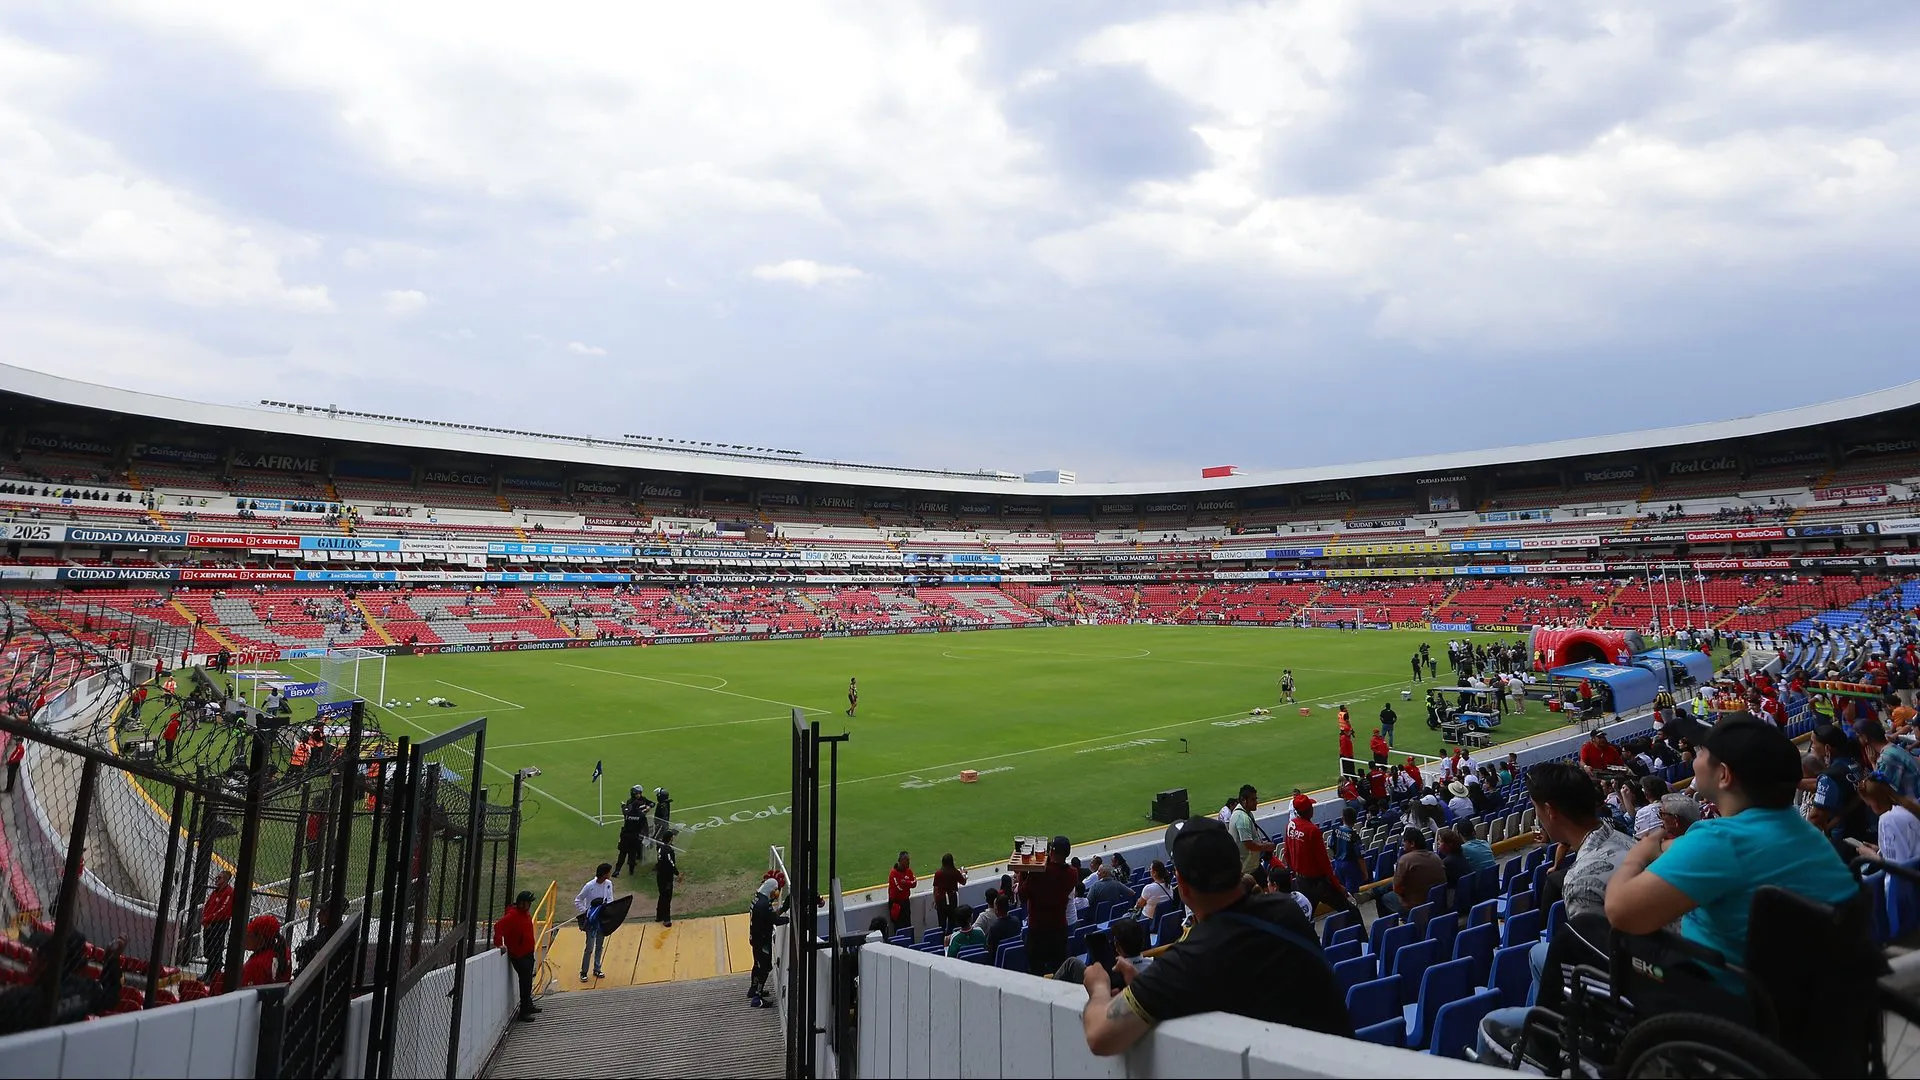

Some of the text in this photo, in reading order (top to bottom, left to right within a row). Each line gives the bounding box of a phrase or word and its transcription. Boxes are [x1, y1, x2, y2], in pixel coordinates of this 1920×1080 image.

[149, 449, 218, 463] Construlandia
[254, 455, 319, 471] AFIRME
[1670, 457, 1736, 474] Red Cola
[424, 471, 459, 483] ARMO
[577, 482, 616, 494] Pack3000
[642, 485, 682, 497] Keuka
[820, 498, 855, 508] AFIRME
[918, 503, 949, 512] AFIRME
[586, 518, 618, 526] HARINERA
[1349, 518, 1403, 529] CIUDAD ADERAS
[13, 526, 51, 540] 2025
[72, 529, 182, 545] CIUDAD MADERAS
[1688, 532, 1733, 541] QuattroCom
[1736, 529, 1782, 539] QuattroCom
[206, 536, 244, 544] XENTRAL
[261, 538, 299, 546] XENTRAL
[1650, 534, 1685, 542] caliente.mx
[317, 537, 363, 549] GALLOS
[693, 550, 747, 558] CIUDAD MADERAS
[805, 552, 846, 560] 1950 2025
[1105, 554, 1129, 562] CIUDAD
[1613, 563, 1646, 571] caliente.mx
[1693, 561, 1739, 569] QuattroCom
[1742, 559, 1789, 568] QuattroCom
[67, 568, 171, 580] CIUDAD MADERAS
[255, 571, 292, 579] XENTRAL
[307, 571, 320, 580] QFC
[372, 572, 386, 580] QFC
[1109, 574, 1132, 582] CIUDAD
[911, 626, 940, 634] caliente.mx
[1396, 622, 1427, 630] BARDAHL
[1485, 624, 1518, 632] CARIBU
[769, 632, 803, 640] caliente.mx
[866, 628, 896, 636] caliente.mx
[654, 636, 694, 645] caliente.mx
[714, 634, 751, 642] caliente.mx
[517, 641, 564, 651] caliente.mx
[589, 639, 632, 648] caliente.mx
[440, 643, 491, 654] caliente.mx
[228, 650, 281, 667] GONHER
[290, 688, 315, 698] BBVA
